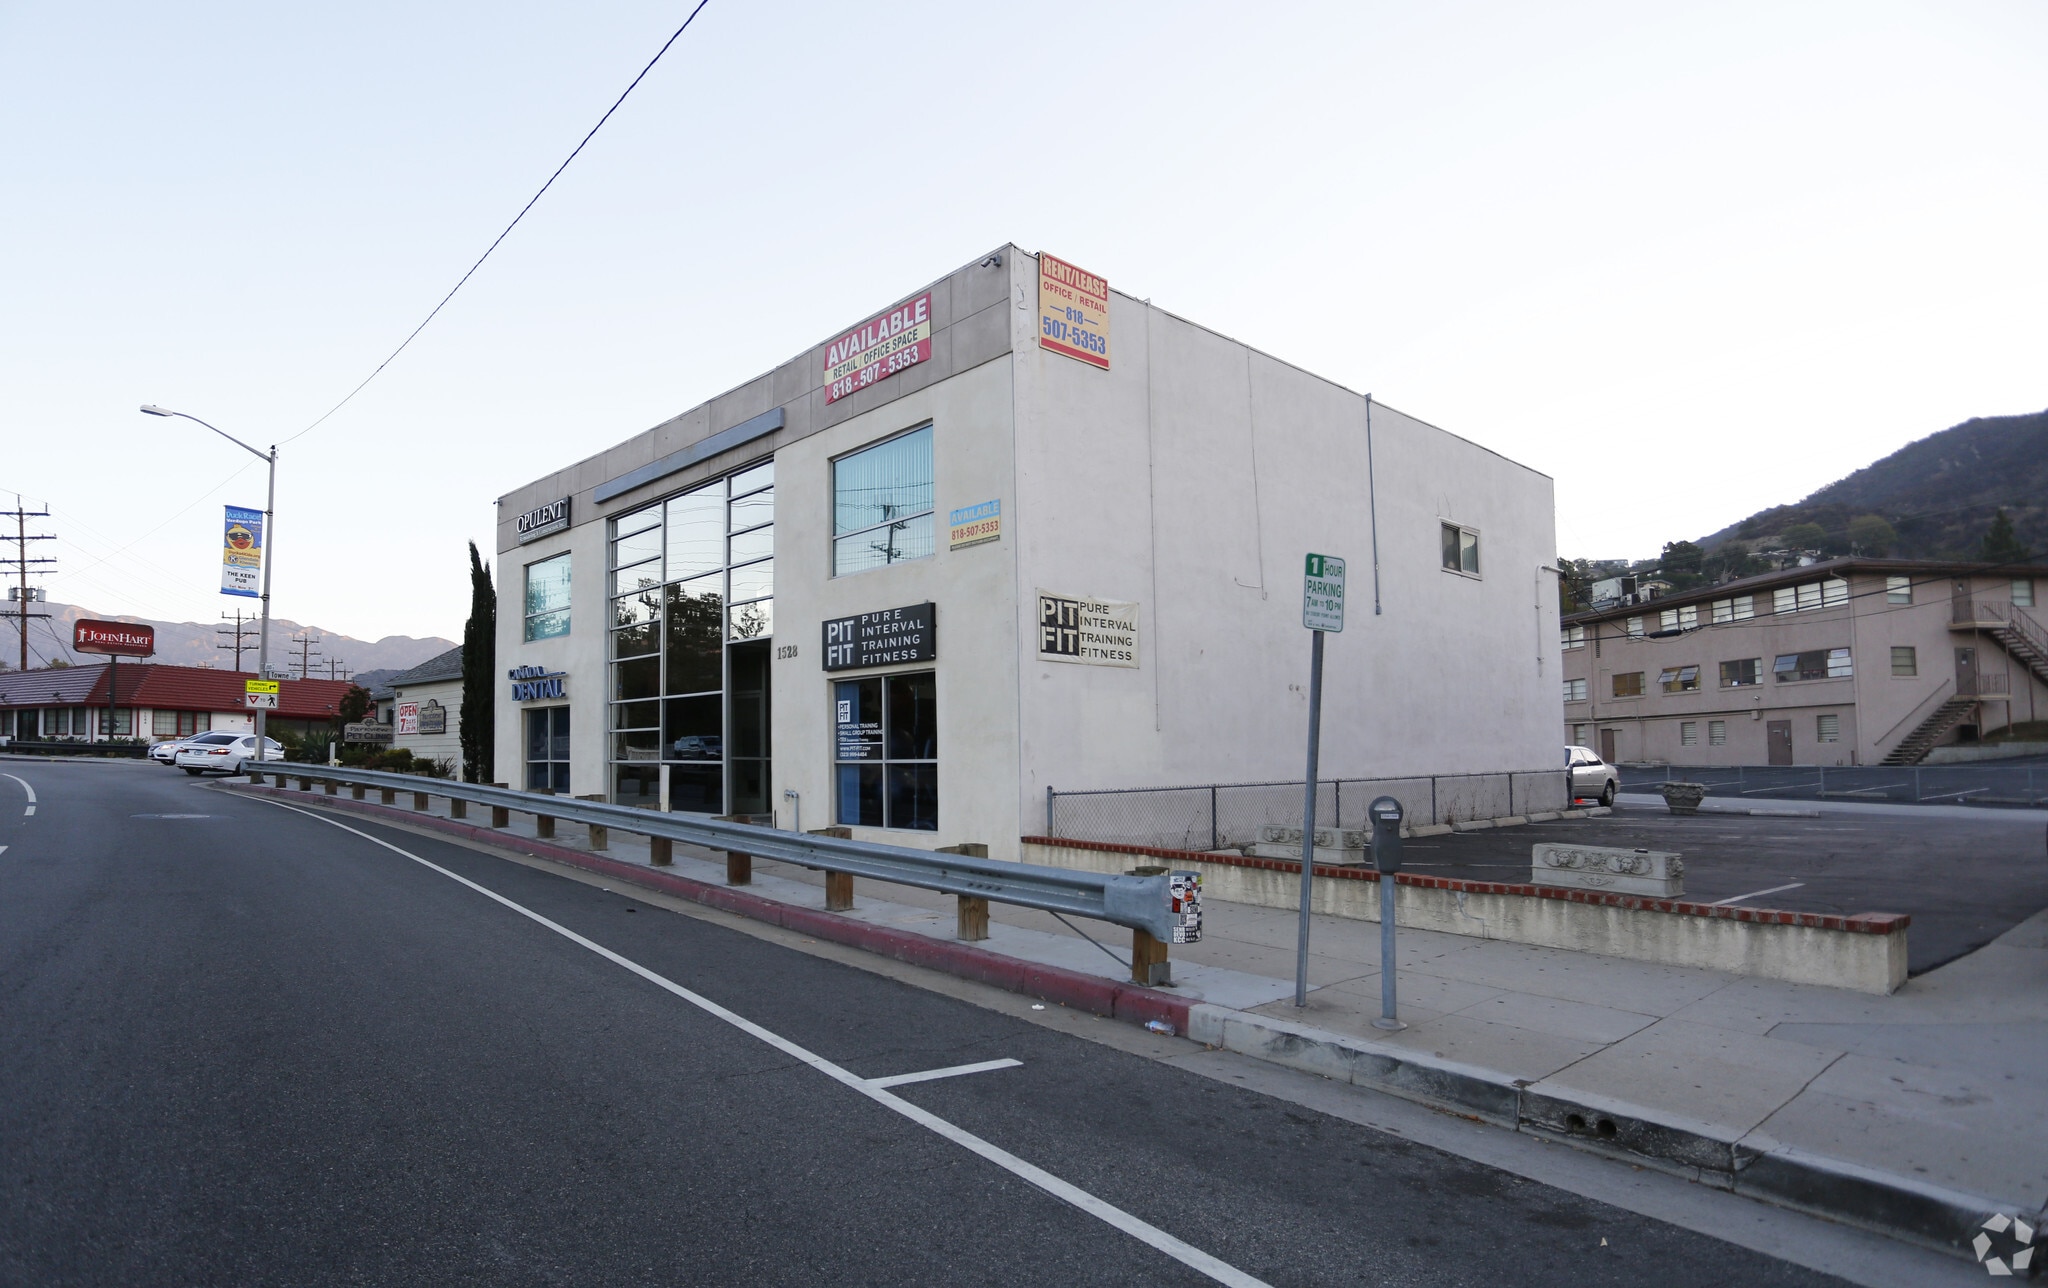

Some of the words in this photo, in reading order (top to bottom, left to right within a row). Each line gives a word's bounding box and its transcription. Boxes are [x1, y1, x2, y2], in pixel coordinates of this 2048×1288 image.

[1044, 257, 1106, 298] RENT/LEASE
[1044, 282, 1072, 300] OFFICE
[1080, 296, 1106, 314] RETAIL
[828, 298, 926, 368] AVAILABLE
[1043, 316, 1106, 354] 507-5353
[834, 359, 857, 380] RETAIL
[864, 342, 890, 364] OFFICE
[893, 329, 918, 350] SPACE
[832, 377, 852, 399] 818
[860, 363, 880, 386] 507
[889, 346, 918, 373] 5353
[517, 500, 564, 532] OPULENT
[952, 502, 998, 524] AVAILABLE
[952, 520, 998, 540] 818-507-5353
[1312, 558, 1318, 574] 1
[1325, 564, 1342, 578] HOUR
[1308, 580, 1342, 598] PARKING
[1041, 599, 1078, 626] PIT
[1080, 602, 1109, 614] PURE
[1307, 596, 1311, 607] 7
[1325, 600, 1333, 611] 10
[862, 610, 901, 624] PURE
[1080, 617, 1136, 631] INTERVAL
[828, 620, 854, 643] PIT
[862, 619, 924, 637] INTERVAL
[862, 634, 920, 650] TRAINING
[1042, 626, 1077, 652] FIT
[1080, 632, 1132, 646] TRAINING
[777, 645, 798, 660] 1528
[828, 644, 853, 666] FIT
[863, 649, 917, 664] FITNESS
[1081, 648, 1132, 660] FITNESS
[512, 678, 564, 701] DENTAL
[400, 705, 416, 717] OPEN
[840, 703, 848, 711] PIT
[840, 712, 848, 720] FIT
[400, 718, 406, 732] 7
